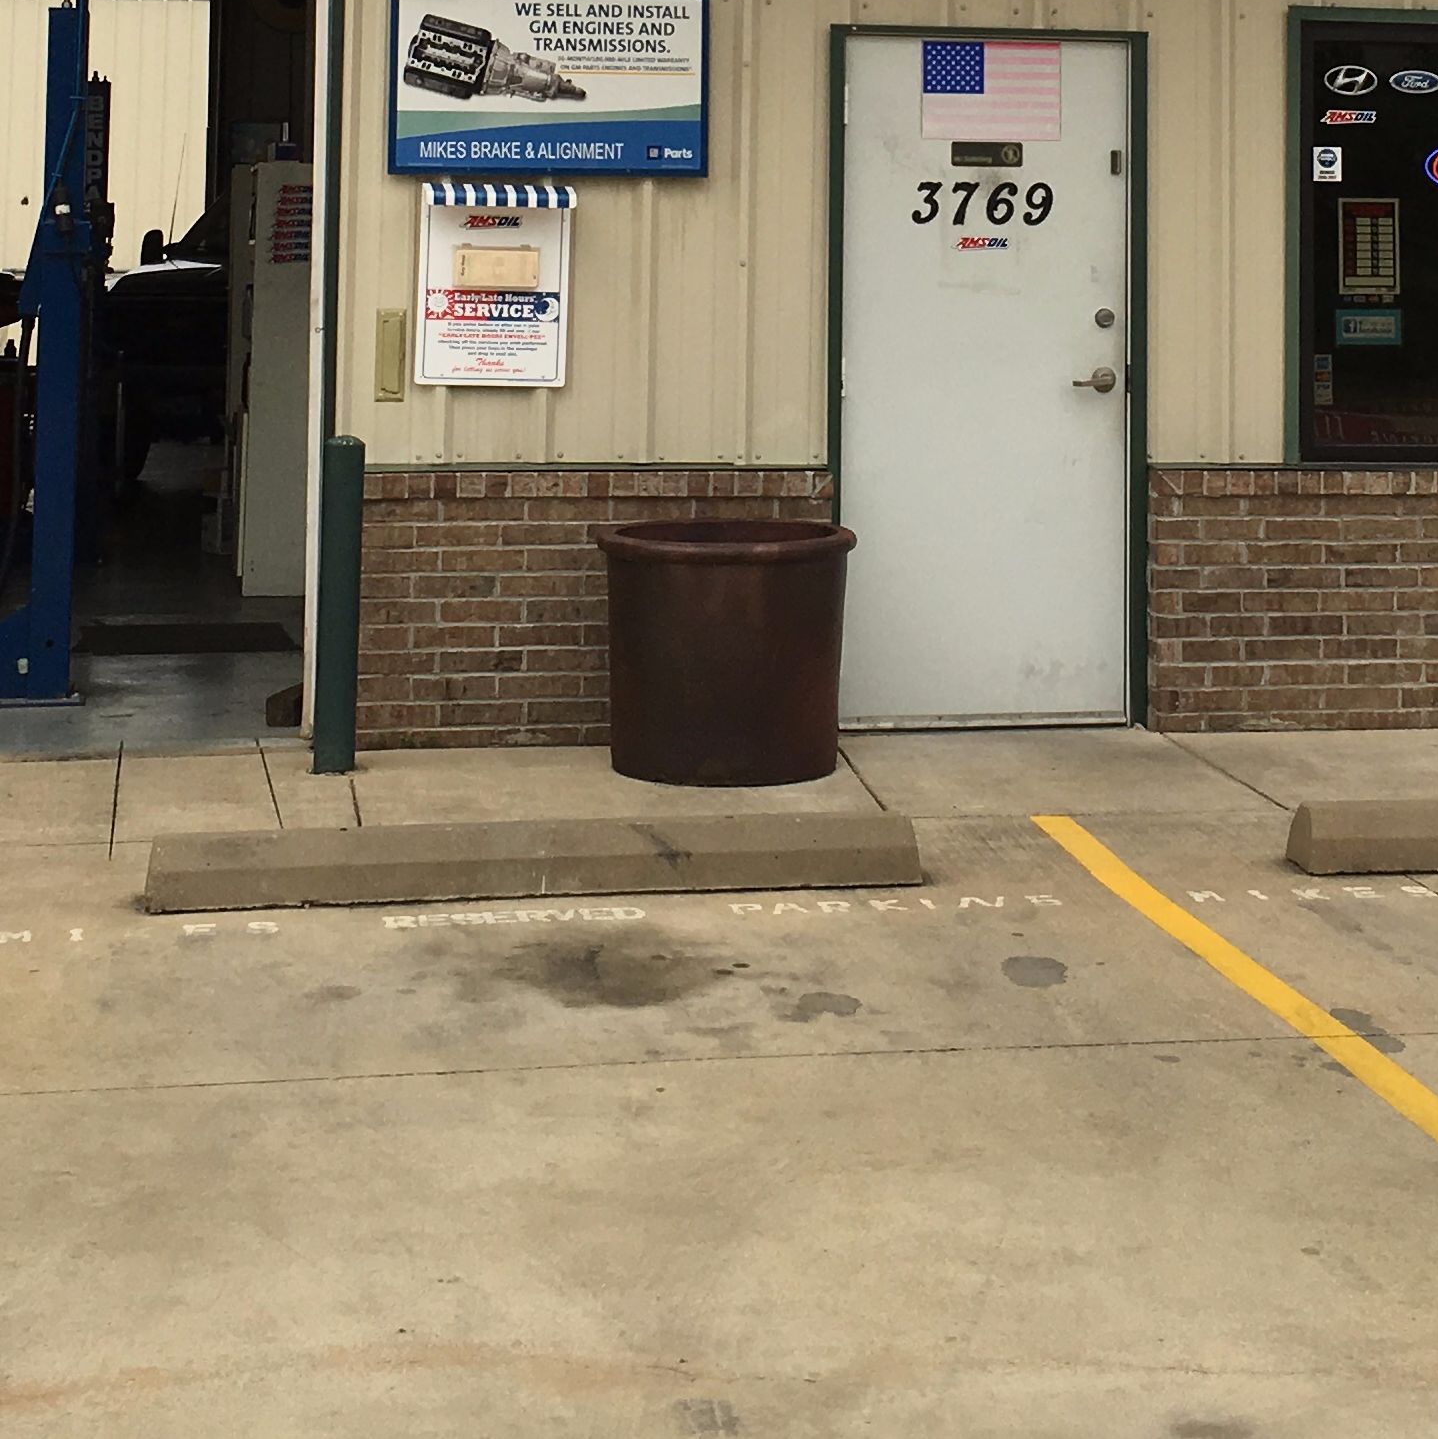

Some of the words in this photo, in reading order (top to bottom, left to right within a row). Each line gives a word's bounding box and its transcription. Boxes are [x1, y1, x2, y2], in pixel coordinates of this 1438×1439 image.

[515, 2, 542, 17] WE
[546, 3, 583, 18] SELL
[585, 4, 624, 19] AND
[627, 5, 691, 20] INSTALL
[529, 20, 558, 35] GM
[562, 21, 635, 36] ENGINES
[637, 22, 676, 37] AND
[533, 37, 672, 54] TRANSMISSIONS.
[1400, 74, 1431, 89] Ford
[1321, 111, 1376, 124] AMSOIL
[419, 141, 467, 159] MIKES
[470, 142, 522, 159] BRAKE
[525, 142, 536, 159] &
[538, 142, 625, 160] ALIGNMENT
[664, 147, 694, 160] Parts
[911, 181, 1054, 226] 3769
[461, 215, 523, 229] AMSOIL
[955, 237, 1009, 250] AMSOIL
[453, 303, 535, 318] SERVICE
[1186, 885, 1438, 903] MIKES
[382, 906, 647, 929] RESERVED
